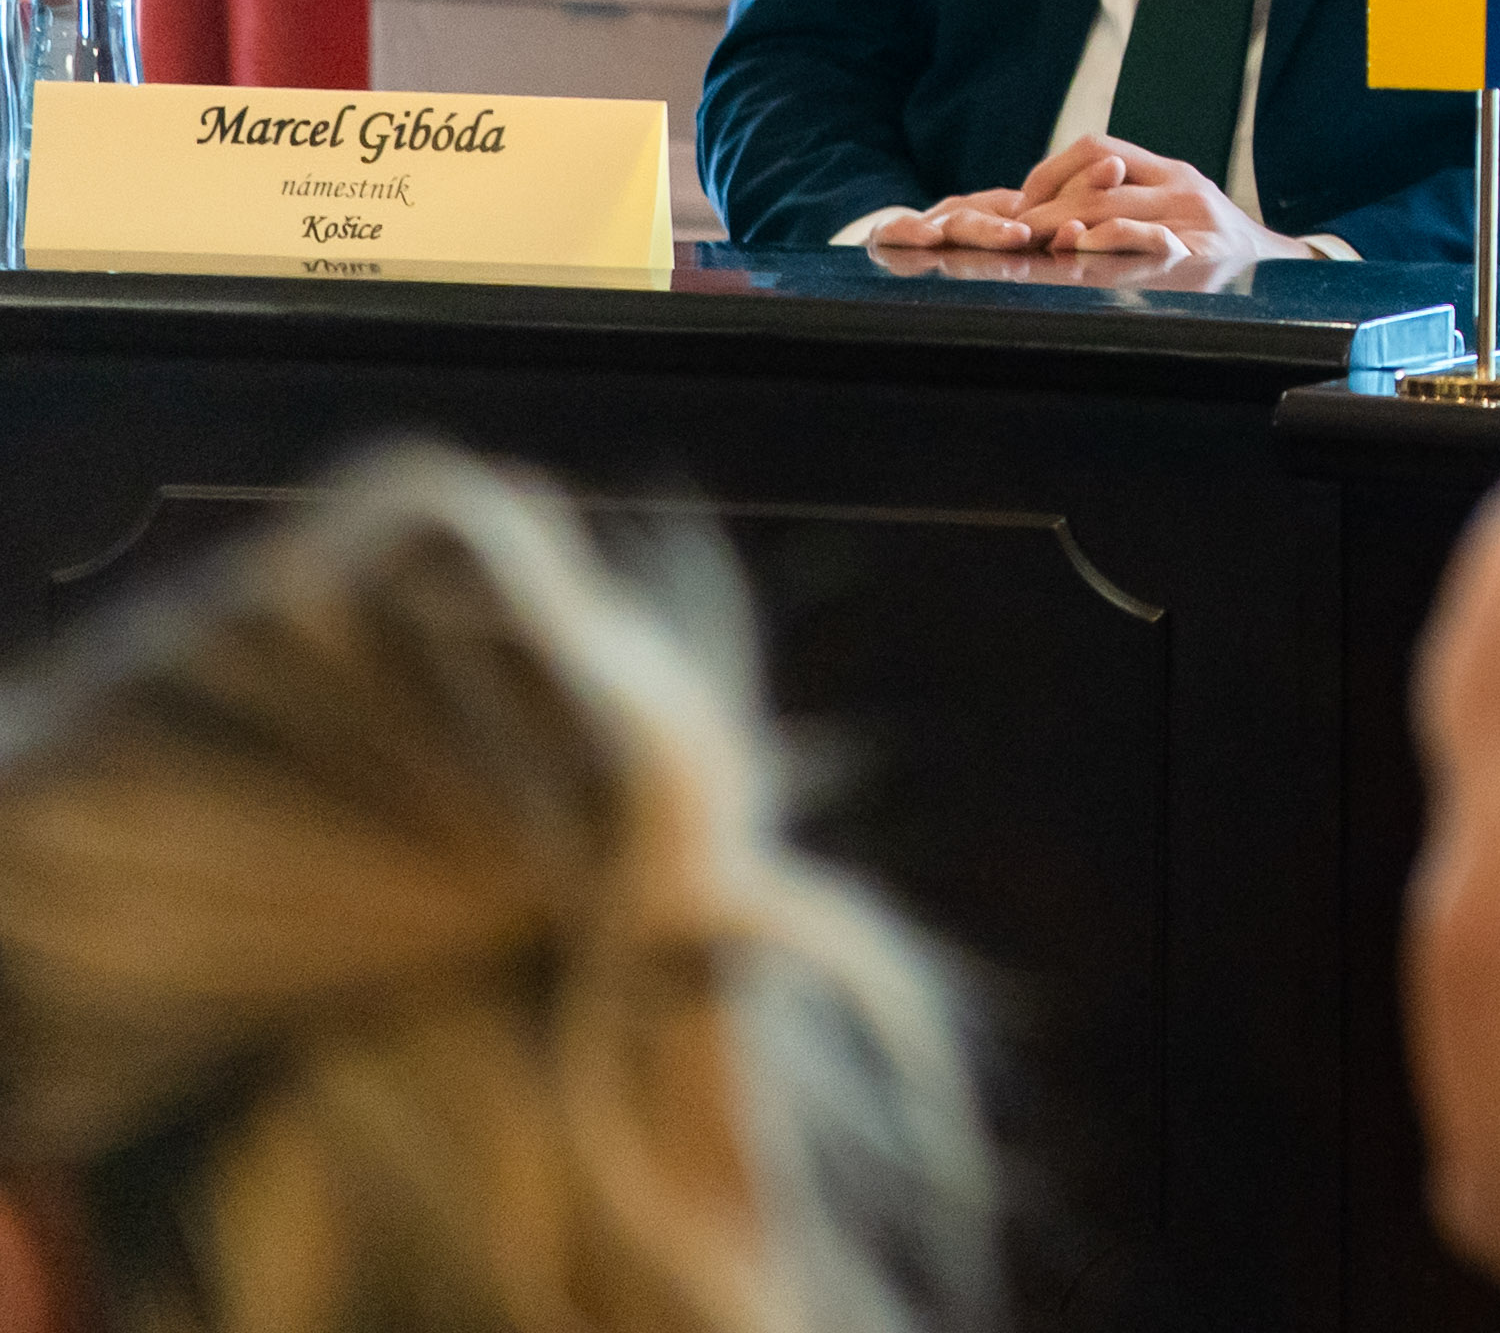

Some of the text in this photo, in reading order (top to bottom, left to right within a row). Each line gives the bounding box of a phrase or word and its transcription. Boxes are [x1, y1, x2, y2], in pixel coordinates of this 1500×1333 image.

[196, 104, 506, 164] Marcel Gibóda
[281, 172, 415, 207] námestník
[302, 214, 383, 243] Košice
